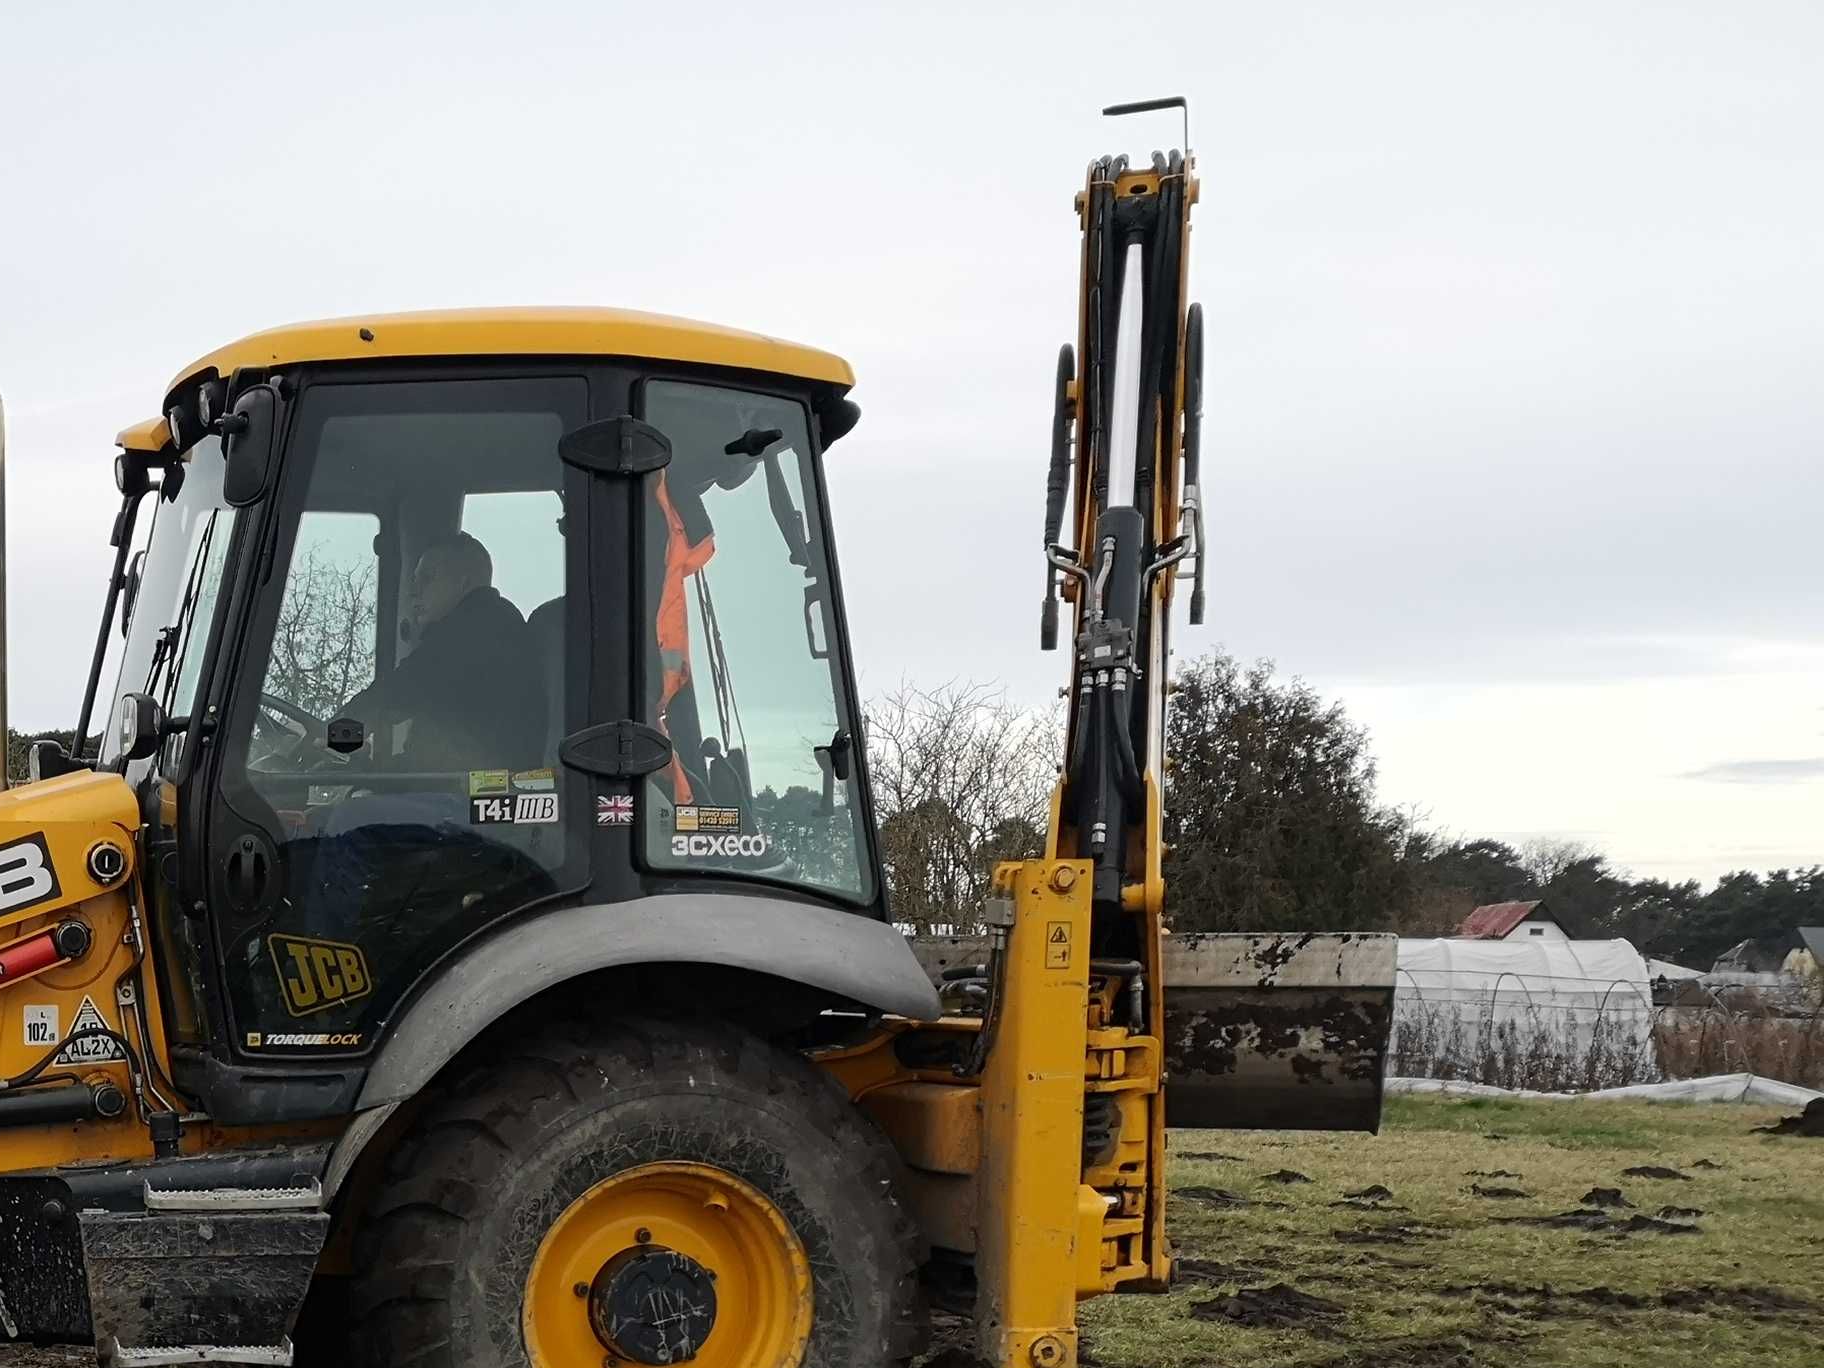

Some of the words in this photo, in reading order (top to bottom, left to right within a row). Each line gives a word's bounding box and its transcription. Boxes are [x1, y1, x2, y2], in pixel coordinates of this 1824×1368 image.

[473, 798, 513, 822] T4i
[287, 943, 365, 1007] JCB
[27, 1022, 48, 1042] 102
[264, 1033, 363, 1045] TORQUELOCK
